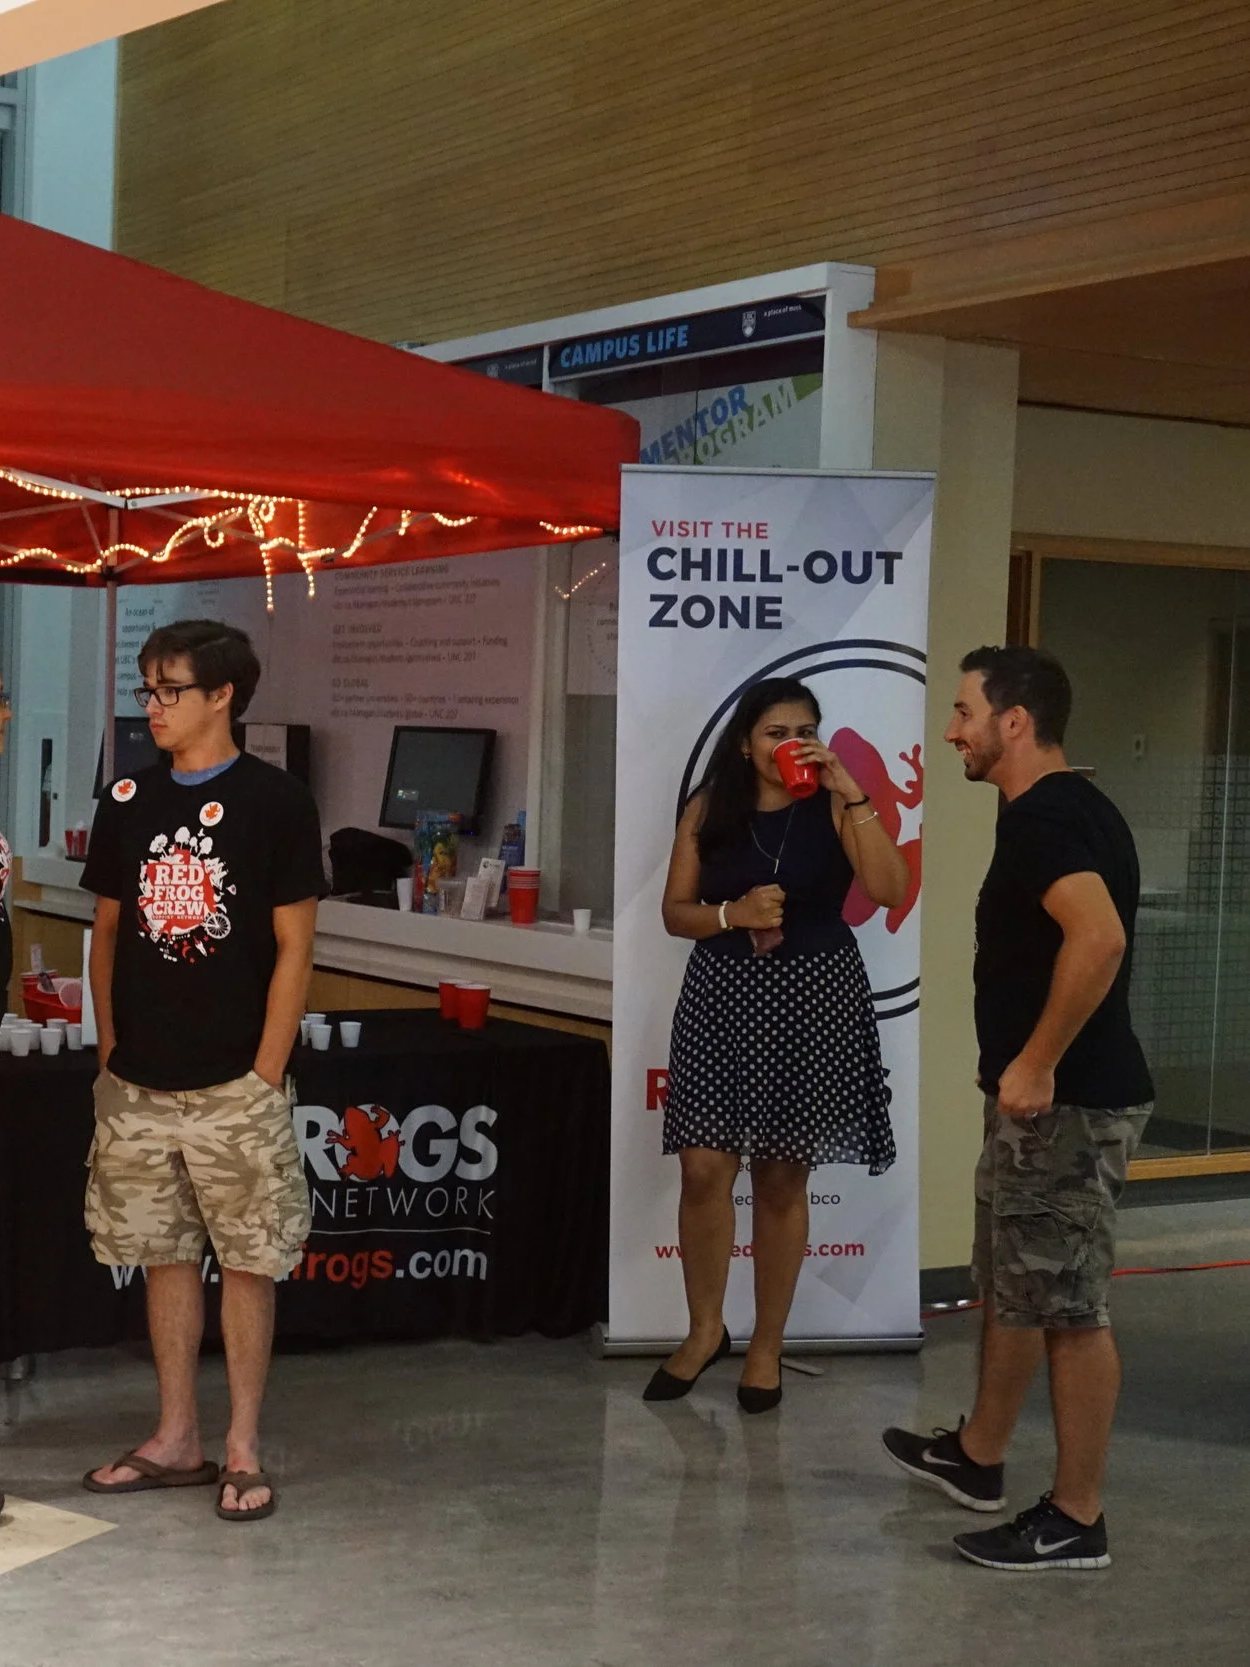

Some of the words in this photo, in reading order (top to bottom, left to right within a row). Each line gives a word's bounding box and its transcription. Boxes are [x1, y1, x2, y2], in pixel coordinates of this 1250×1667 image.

[560, 334, 640, 369] CAMPUS
[646, 324, 689, 353] LIFE
[640, 384, 751, 464] MENTOR
[651, 520, 713, 538] VISIT
[724, 521, 769, 539] THE
[646, 547, 903, 584] CHILL-OUT
[649, 594, 783, 630] ZONE
[154, 864, 205, 885] RED
[151, 901, 205, 915] CREW
[153, 885, 204, 901] FROG
[292, 1103, 499, 1183] ROGS
[311, 1187, 495, 1220] NETWORK
